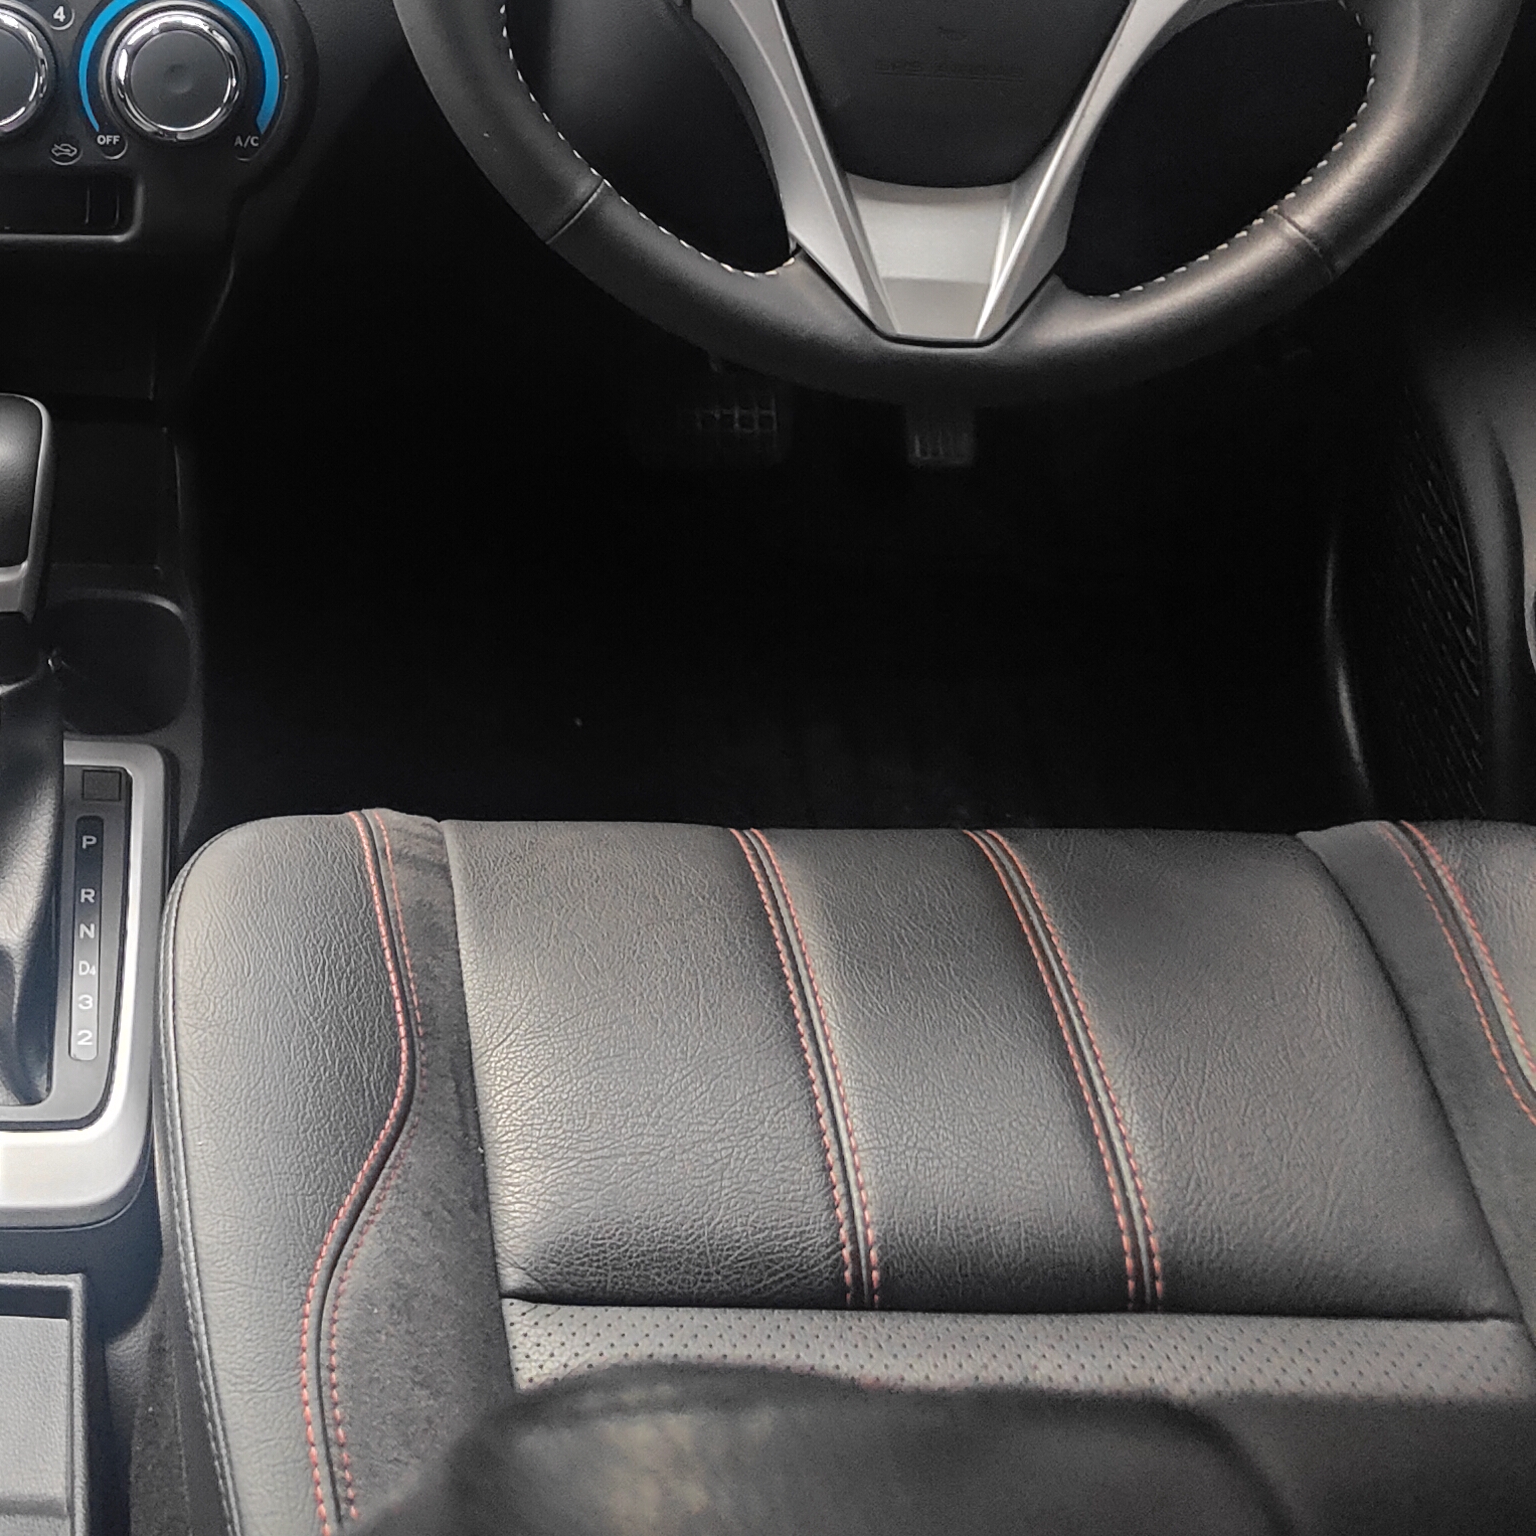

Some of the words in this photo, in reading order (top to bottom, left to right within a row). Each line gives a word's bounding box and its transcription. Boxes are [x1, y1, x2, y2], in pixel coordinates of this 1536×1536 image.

[52, 5, 66, 23] 4
[96, 134, 121, 146] OFF
[234, 134, 259, 148] A/C
[81, 835, 97, 850] P
[80, 888, 95, 904] R
[79, 923, 95, 939] N
[77, 994, 93, 1010] 3
[76, 1029, 93, 1046] 2
